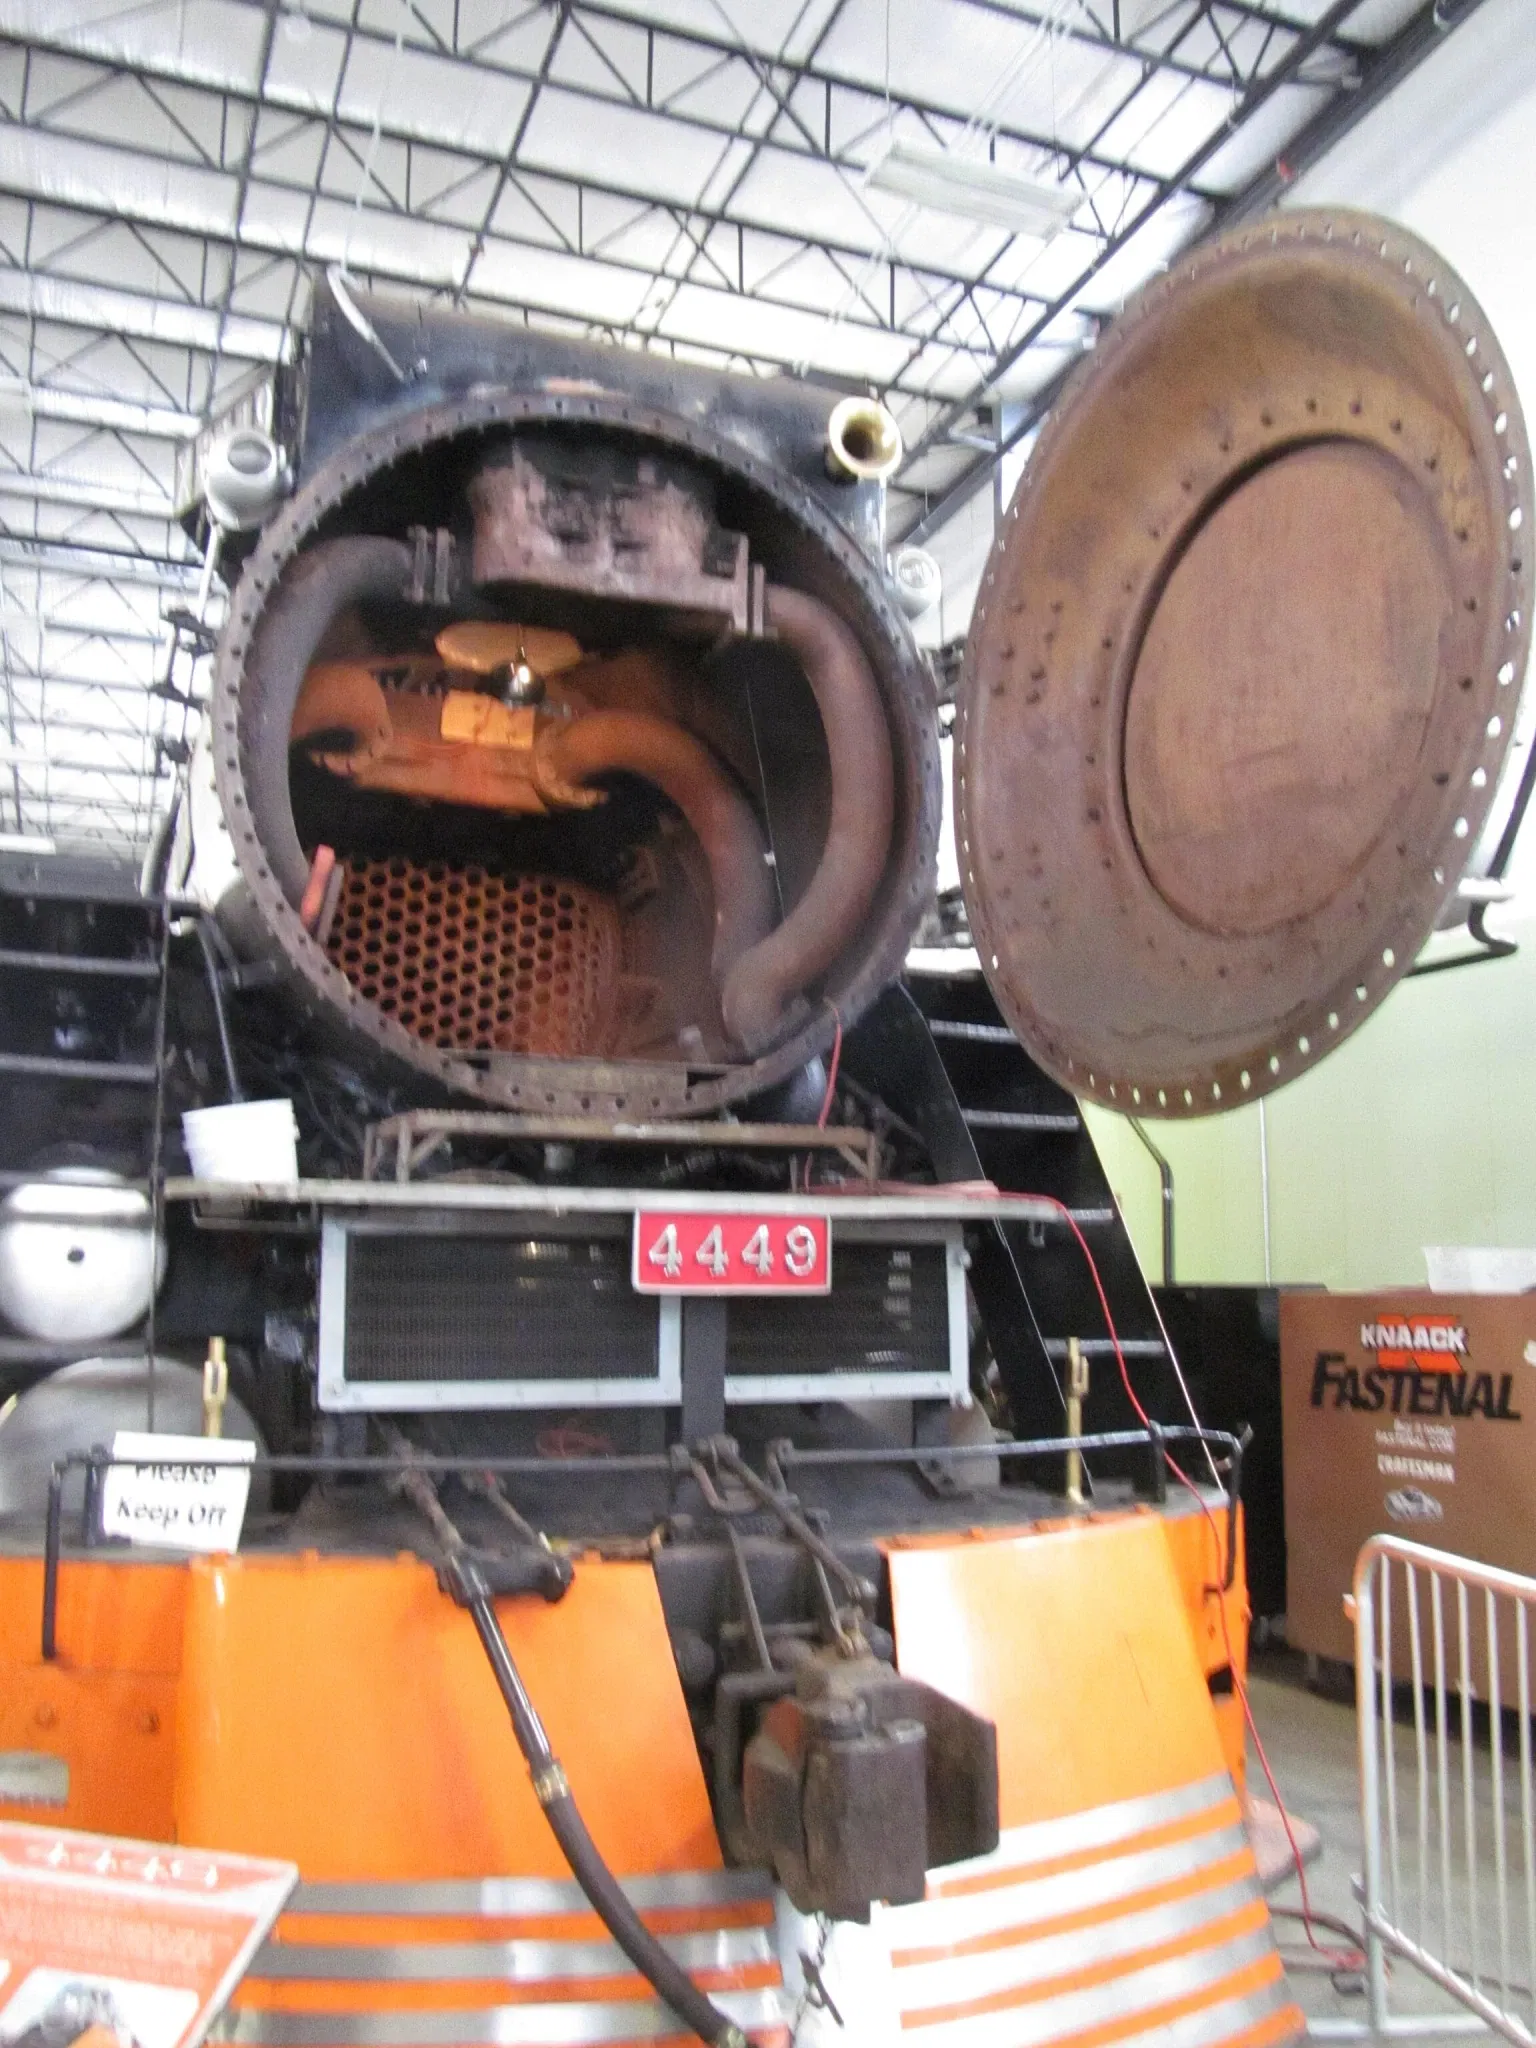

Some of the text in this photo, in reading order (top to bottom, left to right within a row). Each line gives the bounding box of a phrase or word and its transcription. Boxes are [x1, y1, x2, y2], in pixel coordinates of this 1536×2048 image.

[648, 1223, 817, 1278] 4449
[1361, 1323, 1468, 1354] KNAACK
[1311, 1352, 1521, 1420] FASTENAL
[117, 1496, 227, 1531] Keep Off
